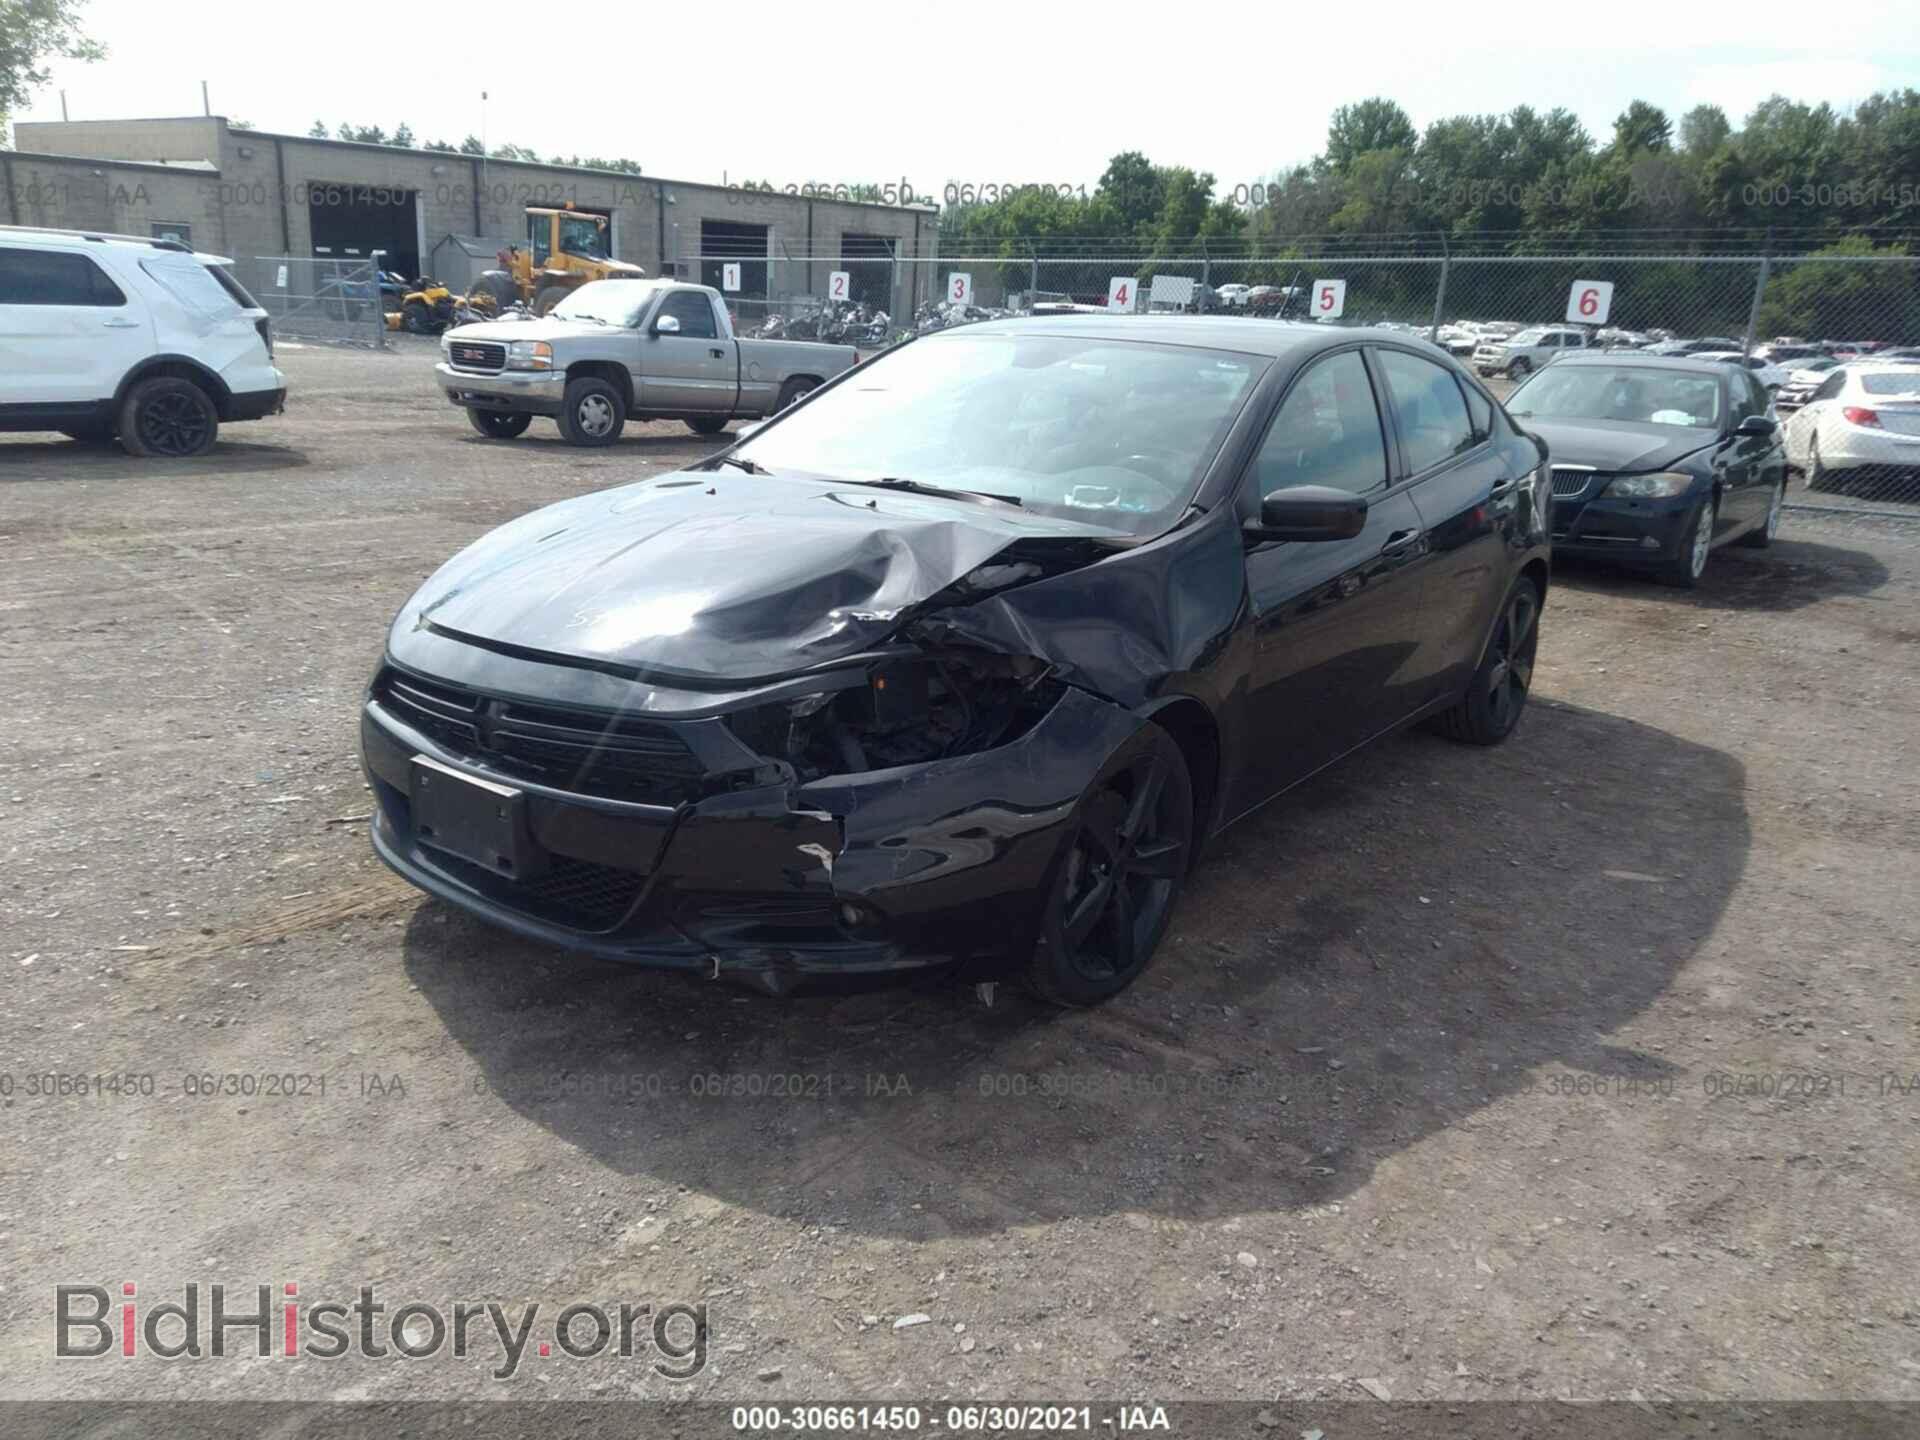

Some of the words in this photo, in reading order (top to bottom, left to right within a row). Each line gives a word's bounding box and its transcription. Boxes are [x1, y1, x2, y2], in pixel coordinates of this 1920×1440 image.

[728, 269, 735, 286] 1
[834, 277, 844, 296] 2
[954, 279, 964, 299] 3
[1115, 284, 1127, 305] 4
[1319, 287, 1334, 310] 5
[1578, 289, 1600, 316] 6
